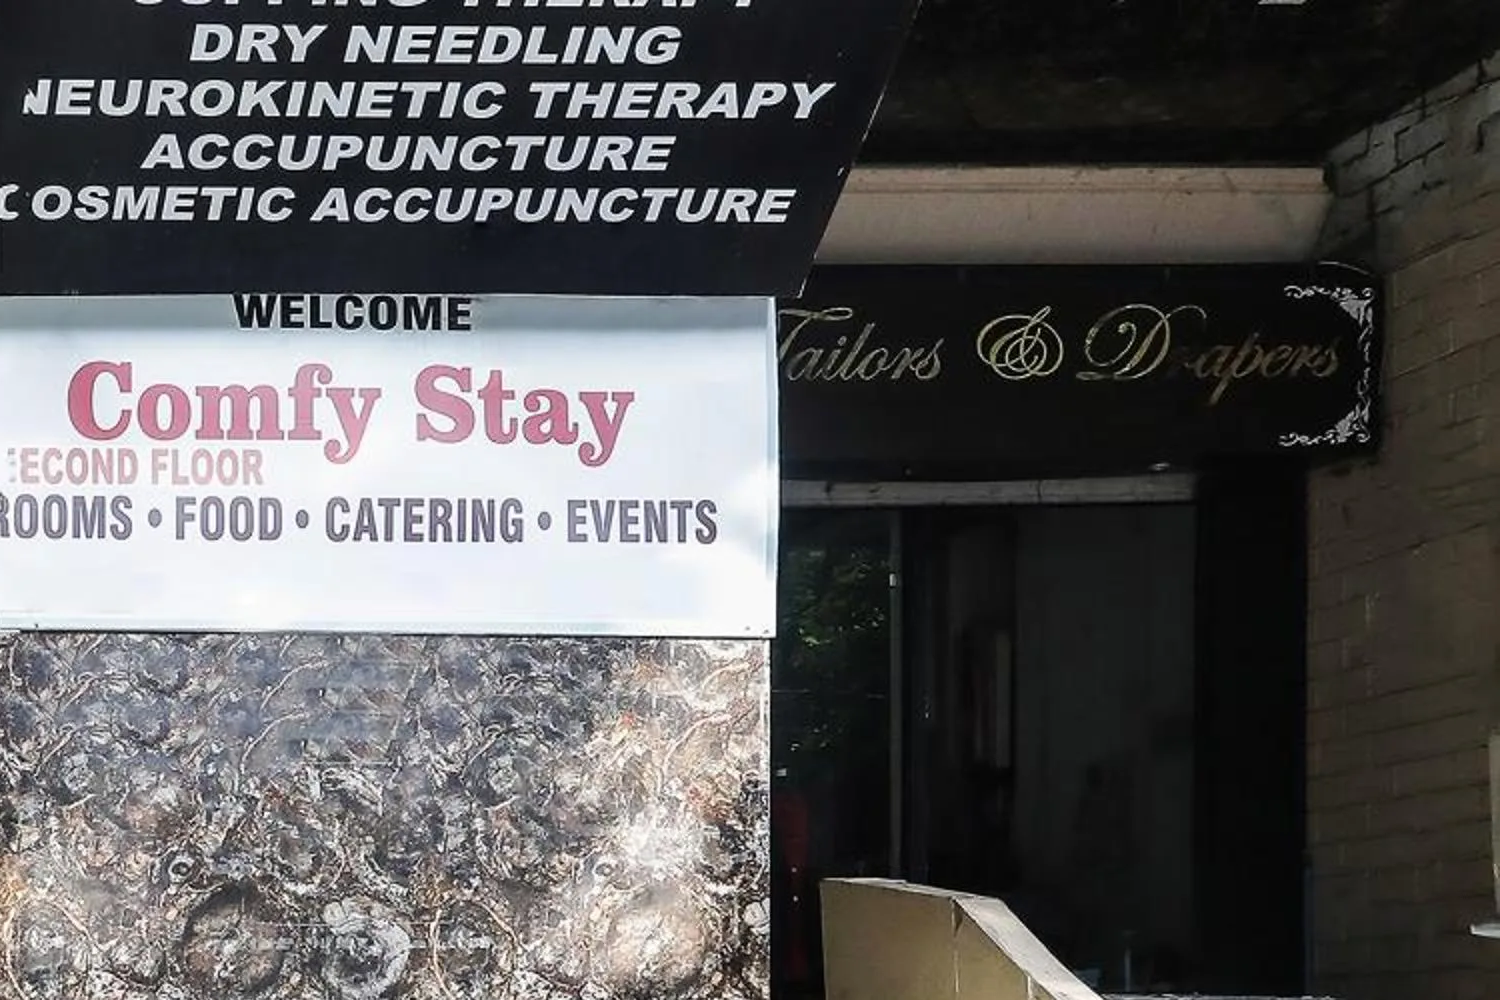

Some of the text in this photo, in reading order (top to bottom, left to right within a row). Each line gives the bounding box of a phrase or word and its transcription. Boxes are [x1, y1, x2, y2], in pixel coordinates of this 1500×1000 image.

[189, 23, 682, 65] DRY NEEDLING
[22, 79, 836, 120] NEUROKINETIC THERAPY
[140, 133, 676, 172] ACCUPUNCTURE
[310, 186, 796, 224] ACCUPUNCTURE
[231, 293, 471, 331] WELCOME
[778, 303, 1341, 406] Tailors & Dapers
[67, 360, 635, 467] Comfy Stay
[7, 447, 138, 486] ECOND
[151, 448, 264, 486] FLOOR
[175, 496, 283, 541] FOOD
[325, 496, 524, 543] CATERING
[566, 499, 718, 545] EVENTS
